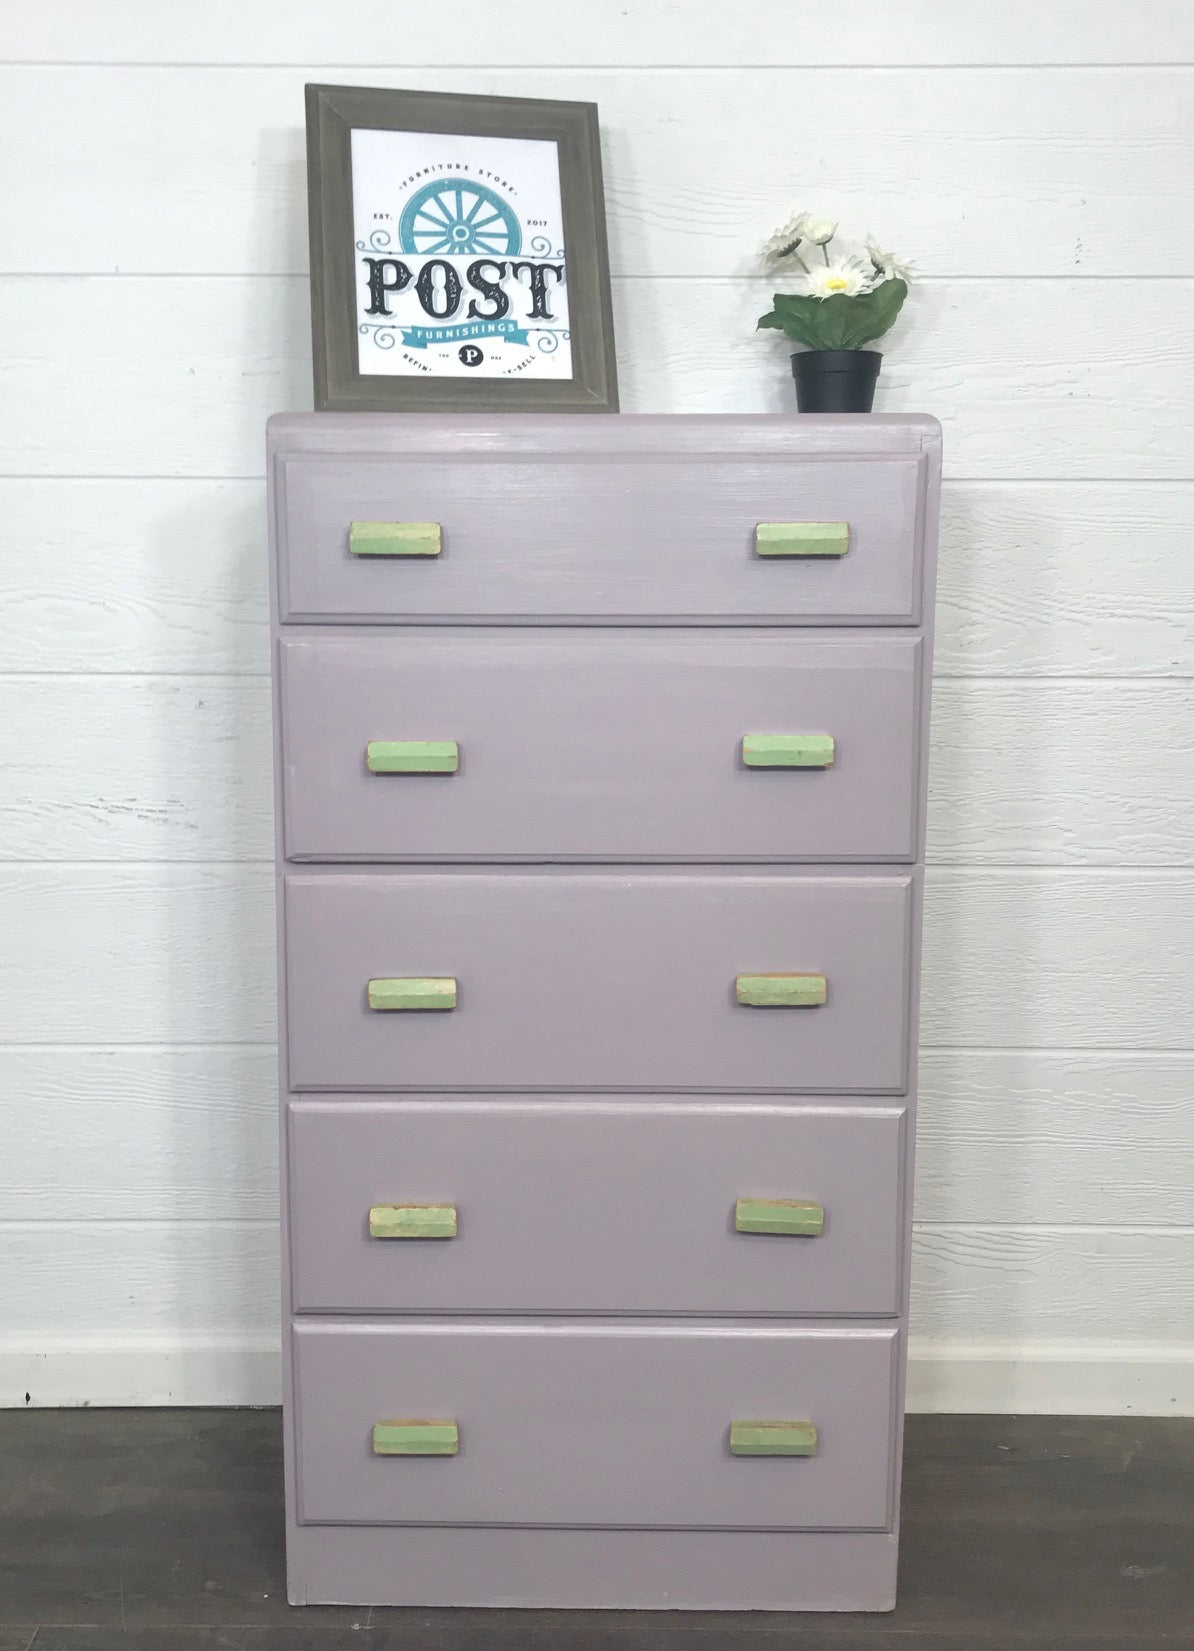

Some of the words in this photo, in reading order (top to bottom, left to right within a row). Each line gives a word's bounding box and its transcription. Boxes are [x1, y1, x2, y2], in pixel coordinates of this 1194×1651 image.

[527, 219, 547, 227] 2017
[362, 257, 565, 321] POST
[417, 323, 515, 339] FURNISHINGS
[465, 348, 479, 363] P
